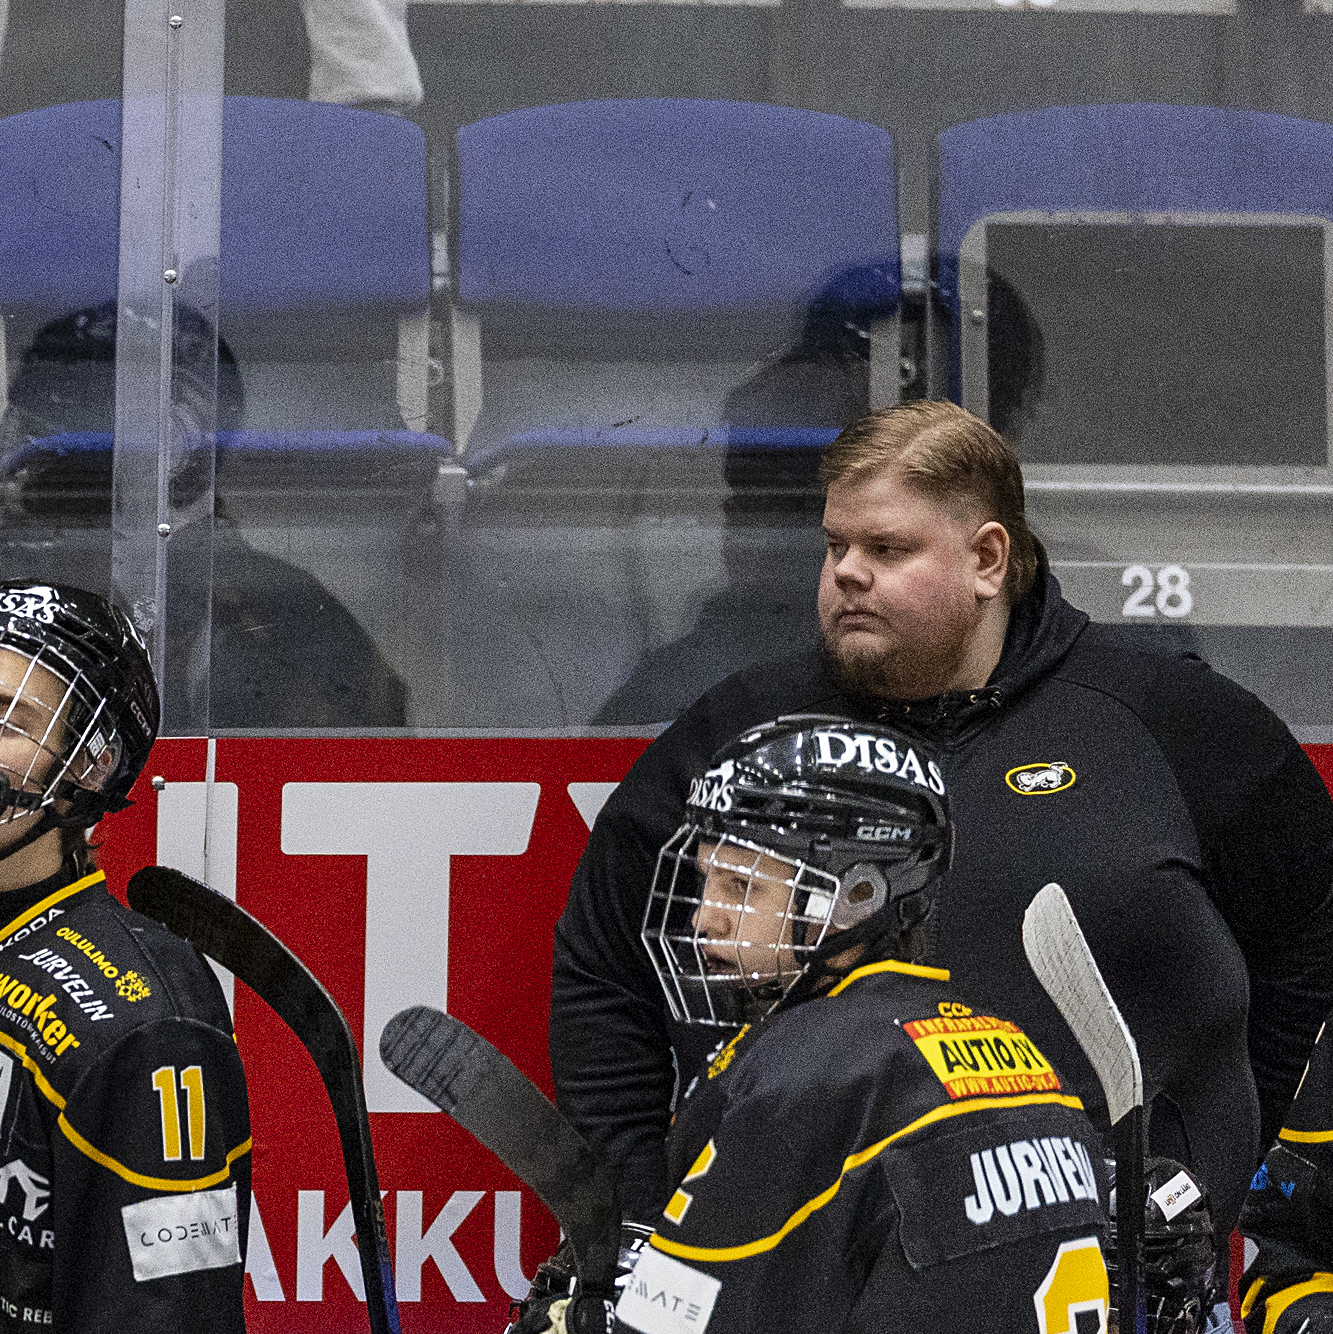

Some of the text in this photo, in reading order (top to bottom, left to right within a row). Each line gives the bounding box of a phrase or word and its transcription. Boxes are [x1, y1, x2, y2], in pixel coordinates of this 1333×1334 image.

[1121, 565, 1193, 618] 28
[815, 731, 946, 796] DISAS
[856, 825, 912, 842] CCM
[56, 927, 119, 979] OULULIMO
[18, 948, 114, 1022] JURVELIN
[938, 1036, 1017, 1074] AUTIO
[152, 1065, 208, 1162] 11
